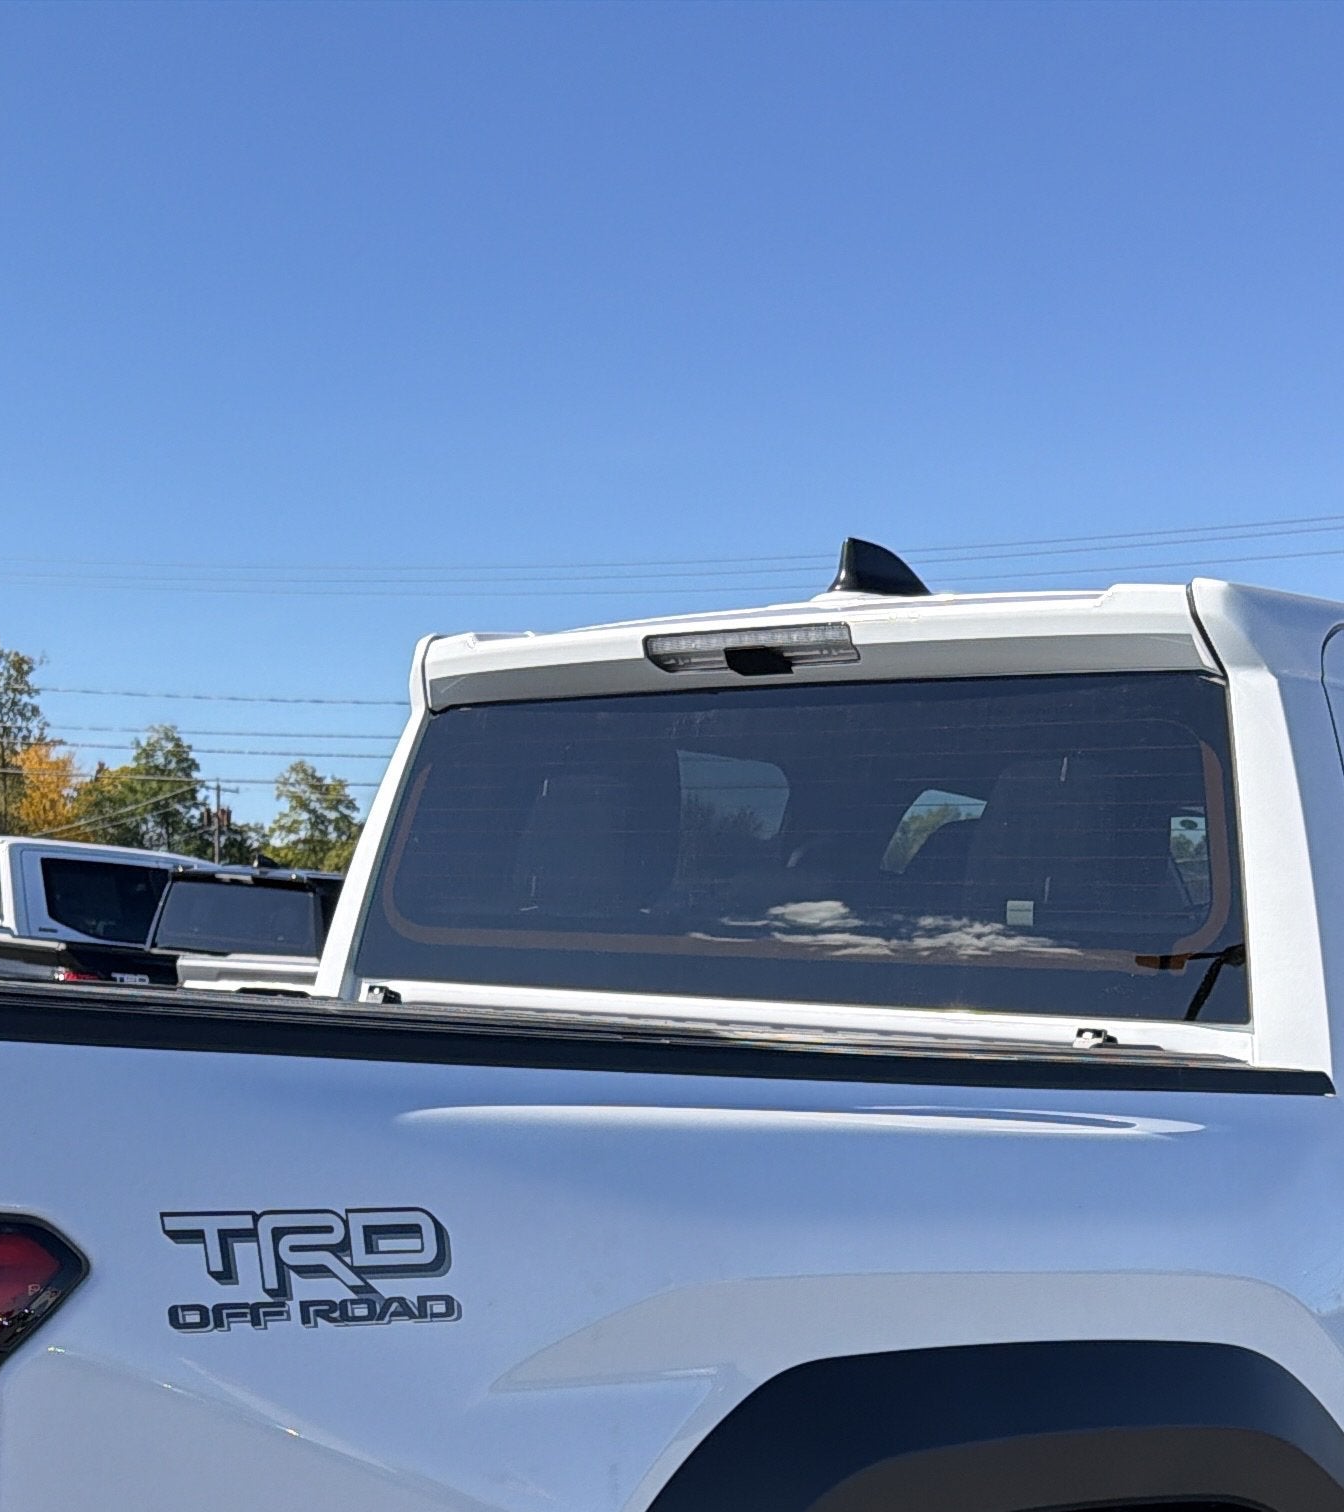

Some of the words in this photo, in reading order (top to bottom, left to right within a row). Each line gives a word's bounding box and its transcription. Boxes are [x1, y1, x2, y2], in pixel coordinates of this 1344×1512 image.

[160, 1207, 452, 1301] TRD
[168, 1302, 291, 1333] OFF
[299, 1294, 462, 1328] ROAD
